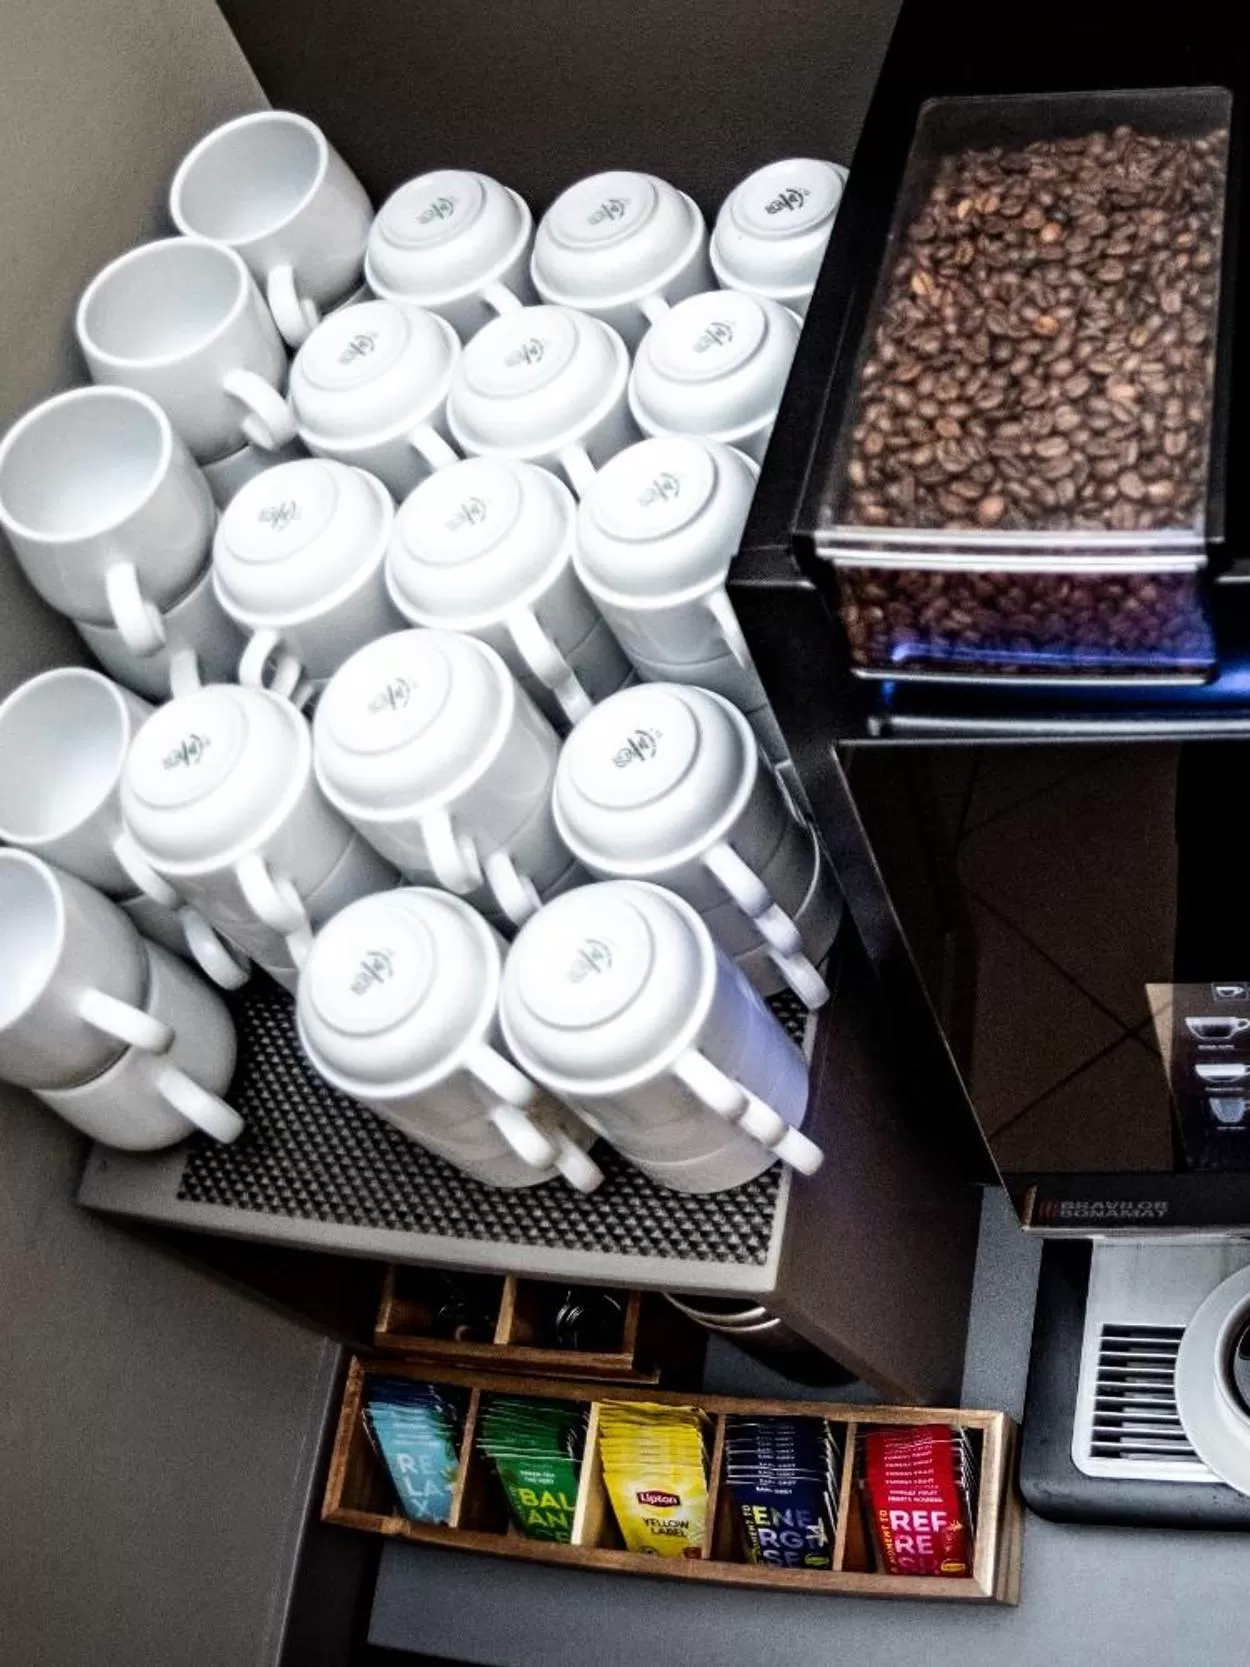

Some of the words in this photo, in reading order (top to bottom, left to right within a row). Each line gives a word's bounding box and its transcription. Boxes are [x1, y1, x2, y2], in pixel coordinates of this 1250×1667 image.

[397, 1452, 437, 1475] RE
[518, 1488, 577, 1512] BAL
[640, 1493, 678, 1506] Lipton
[641, 1516, 689, 1529] YELLOW
[751, 1505, 811, 1528] ENE
[888, 1510, 948, 1533] REF
[650, 1527, 687, 1538] LABEL
[894, 1535, 934, 1555] RE
